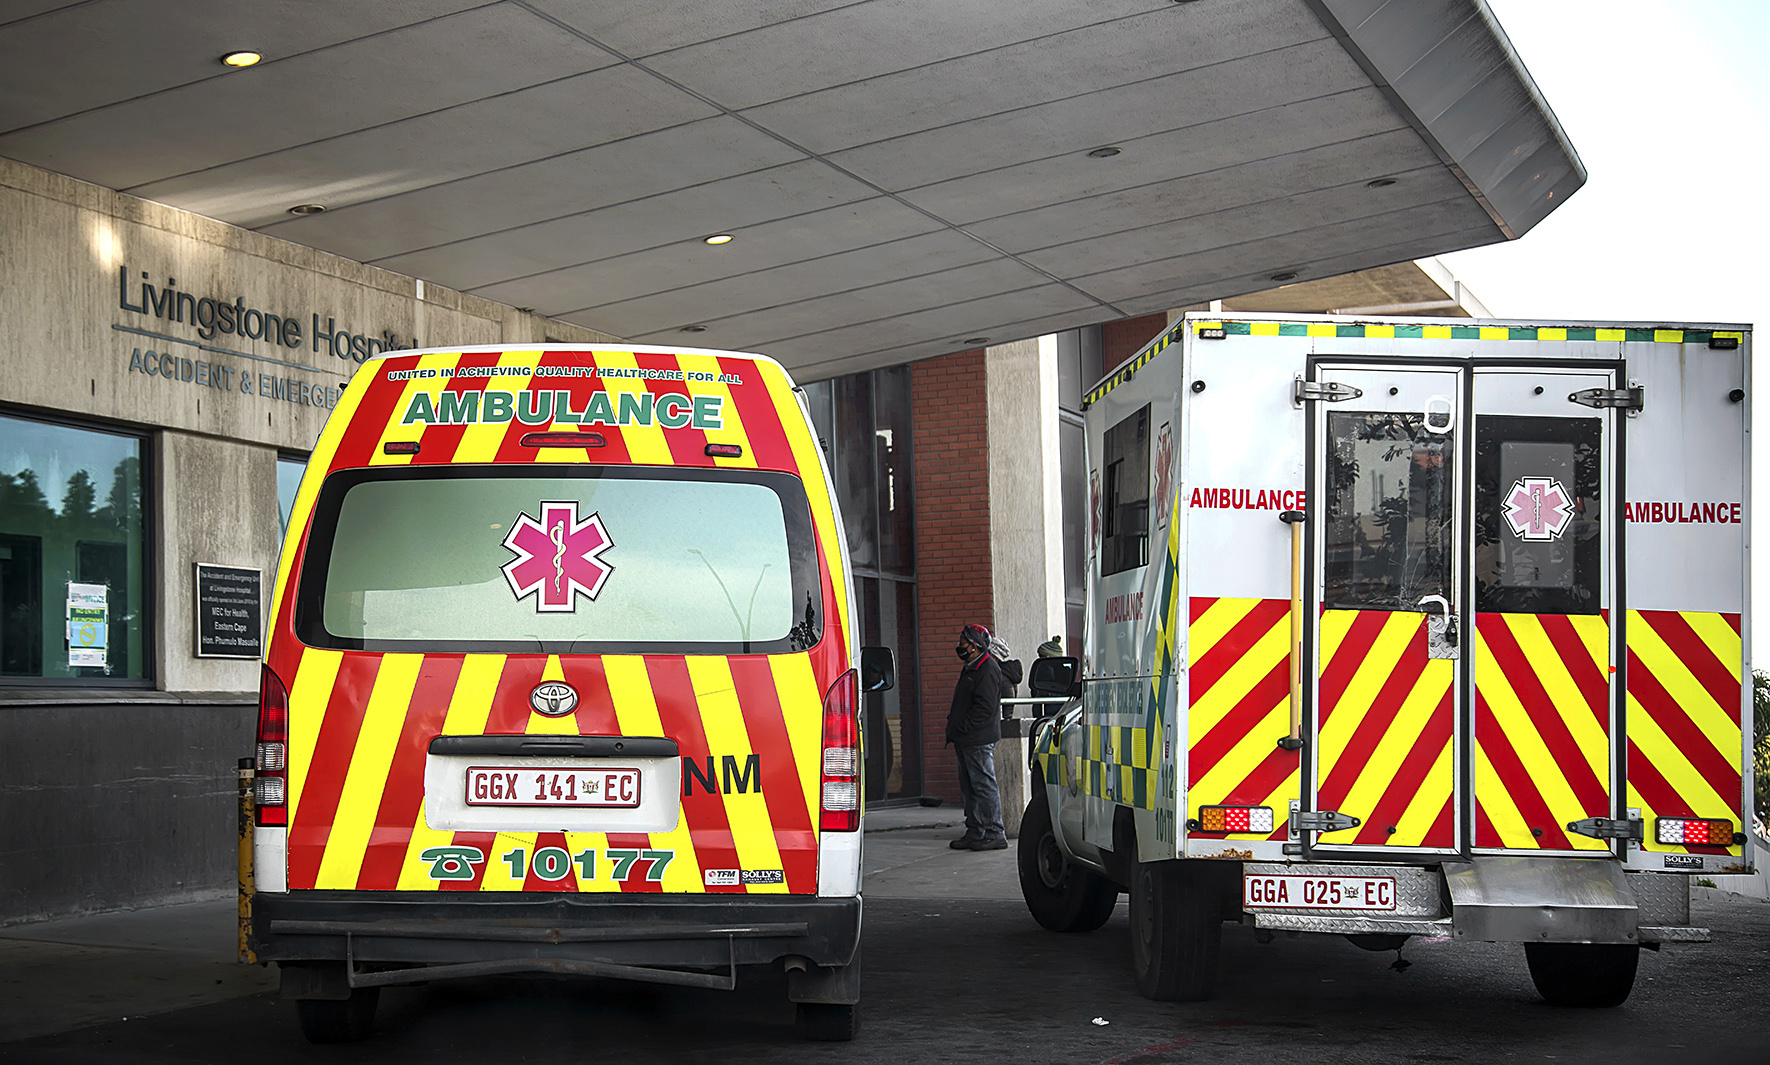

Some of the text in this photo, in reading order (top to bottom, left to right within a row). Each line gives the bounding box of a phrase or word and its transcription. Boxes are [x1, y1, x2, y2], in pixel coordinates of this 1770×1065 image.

[120, 265, 301, 348] Livingstone
[129, 347, 235, 391] ACCIDENT
[240, 370, 253, 395] &
[388, 366, 743, 385] UNITED IN ACHIEVING QUALITY HEALTHCARE FOR ALL
[399, 389, 724, 430] AMBULANCE
[1189, 487, 1306, 511] AMBULANCE
[1625, 502, 1742, 524] AMBULANCE
[224, 608, 232, 617] for
[1105, 591, 1143, 625] AMBULANCE
[214, 621, 247, 633] Eastern Cape
[475, 773, 633, 801] GGX 141 EC
[682, 754, 761, 796] NM
[1161, 763, 1174, 799] 112
[501, 846, 676, 882] 10177
[1665, 855, 1702, 864] SOLLY'S
[716, 870, 736, 878] TFM
[742, 870, 782, 879] SOLLY'S
[1250, 879, 1390, 906] GGA 025 EC
